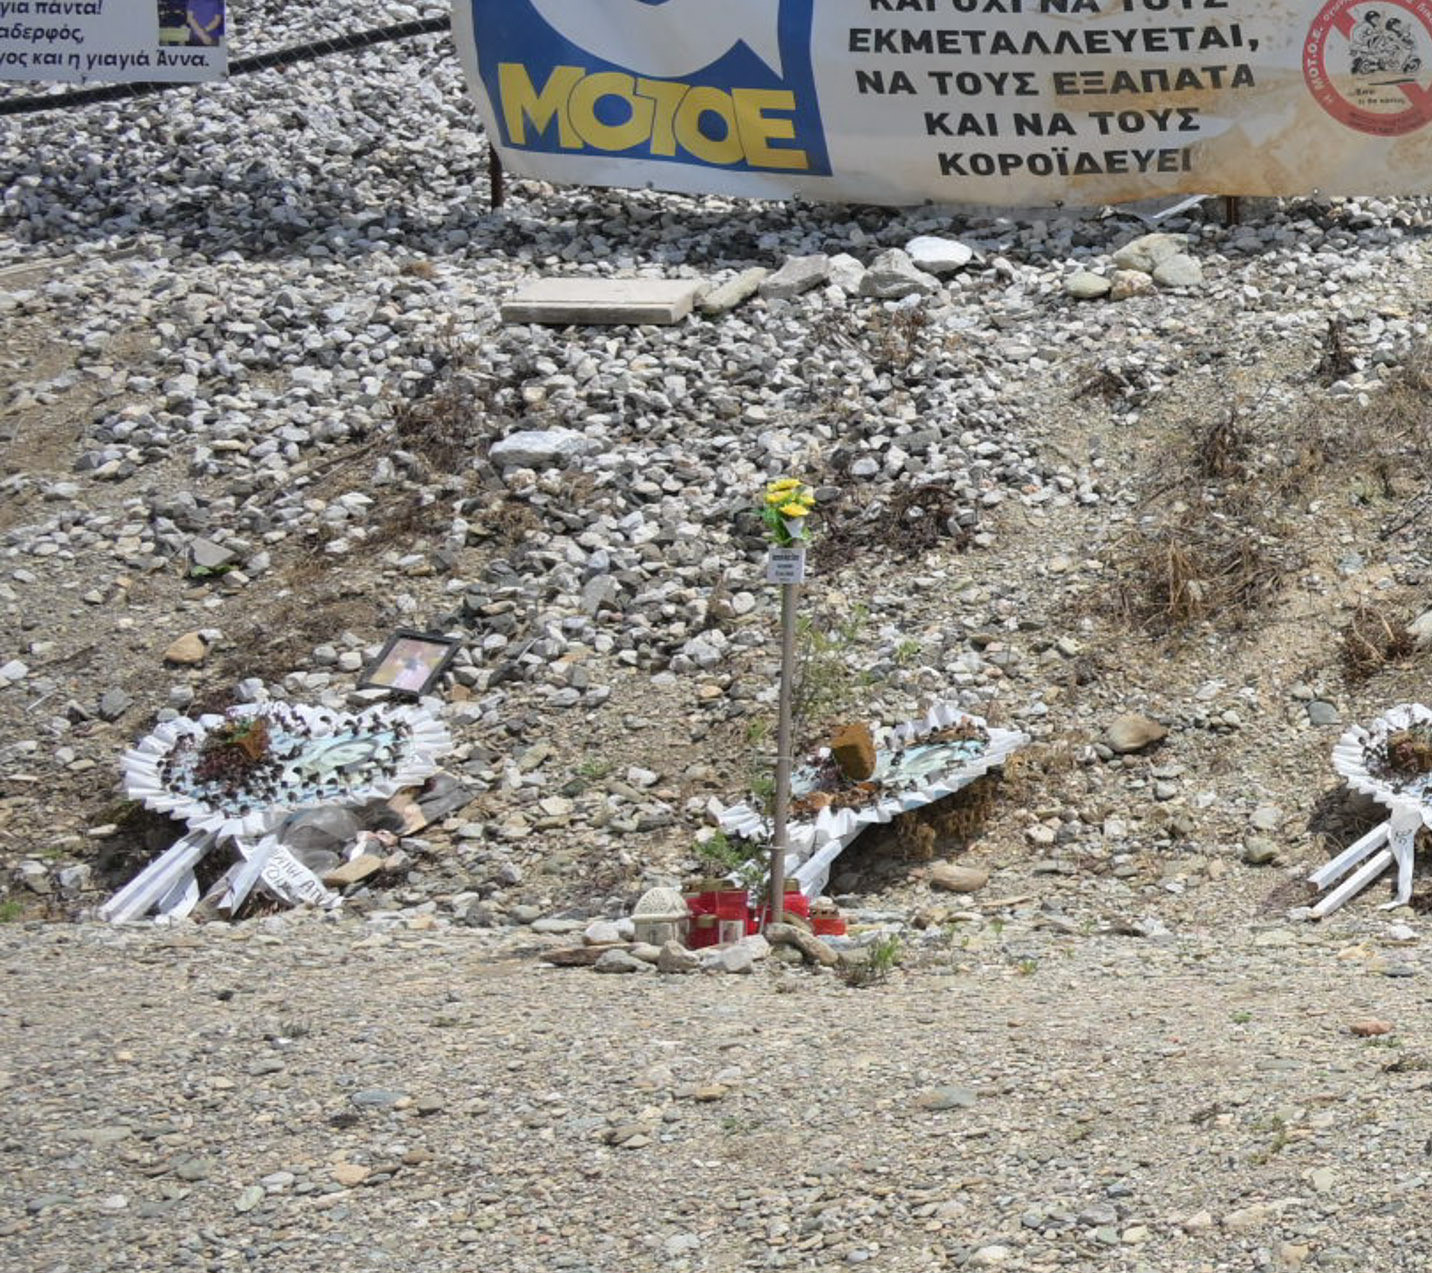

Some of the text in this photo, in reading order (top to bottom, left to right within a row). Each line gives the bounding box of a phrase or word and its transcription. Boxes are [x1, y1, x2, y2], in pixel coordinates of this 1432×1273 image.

[848, 23, 1260, 56] ΕΚΜΕΤΑΛΛΕΥΕΤΑΙ,
[33, 50, 211, 72] και η γιαγιά Άννα.
[855, 63, 1256, 97] ΝΑ ΤΟΥΣ ΕΞΑΠΑΤΑ
[498, 62, 809, 170] ΜΟΤΟΕ
[923, 107, 1201, 137] ΚΑΙ ΝΑ ΤΟΥΣ
[937, 147, 1193, 177] ΚΟΡΟΪΔΕΥΕΙ
